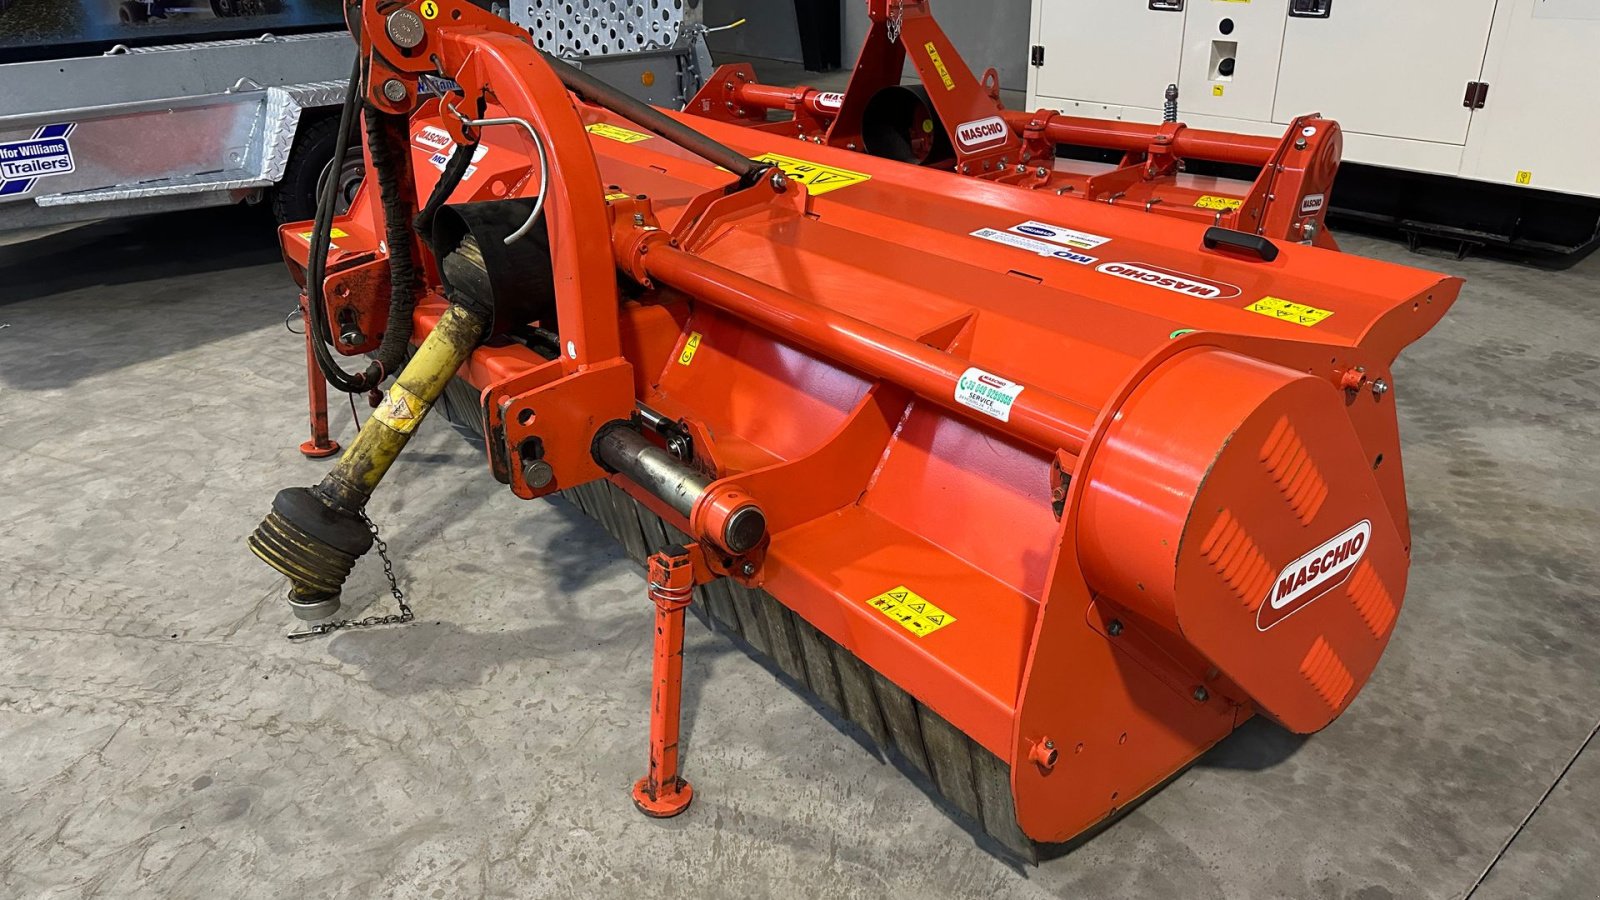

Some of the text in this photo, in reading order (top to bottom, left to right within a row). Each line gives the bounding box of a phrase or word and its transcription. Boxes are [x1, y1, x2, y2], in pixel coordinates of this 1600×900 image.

[961, 122, 1003, 141] MASCHIO
[18, 143, 65, 156] Williams
[3, 158, 69, 174] Trailers
[1303, 198, 1322, 208] MASCHIO
[1053, 251, 1092, 263] MO
[1105, 265, 1215, 296] MASCHIO
[983, 375, 1007, 386] MASCHIO
[969, 392, 994, 406] SERVICE
[1275, 532, 1365, 602] MASCHIO
